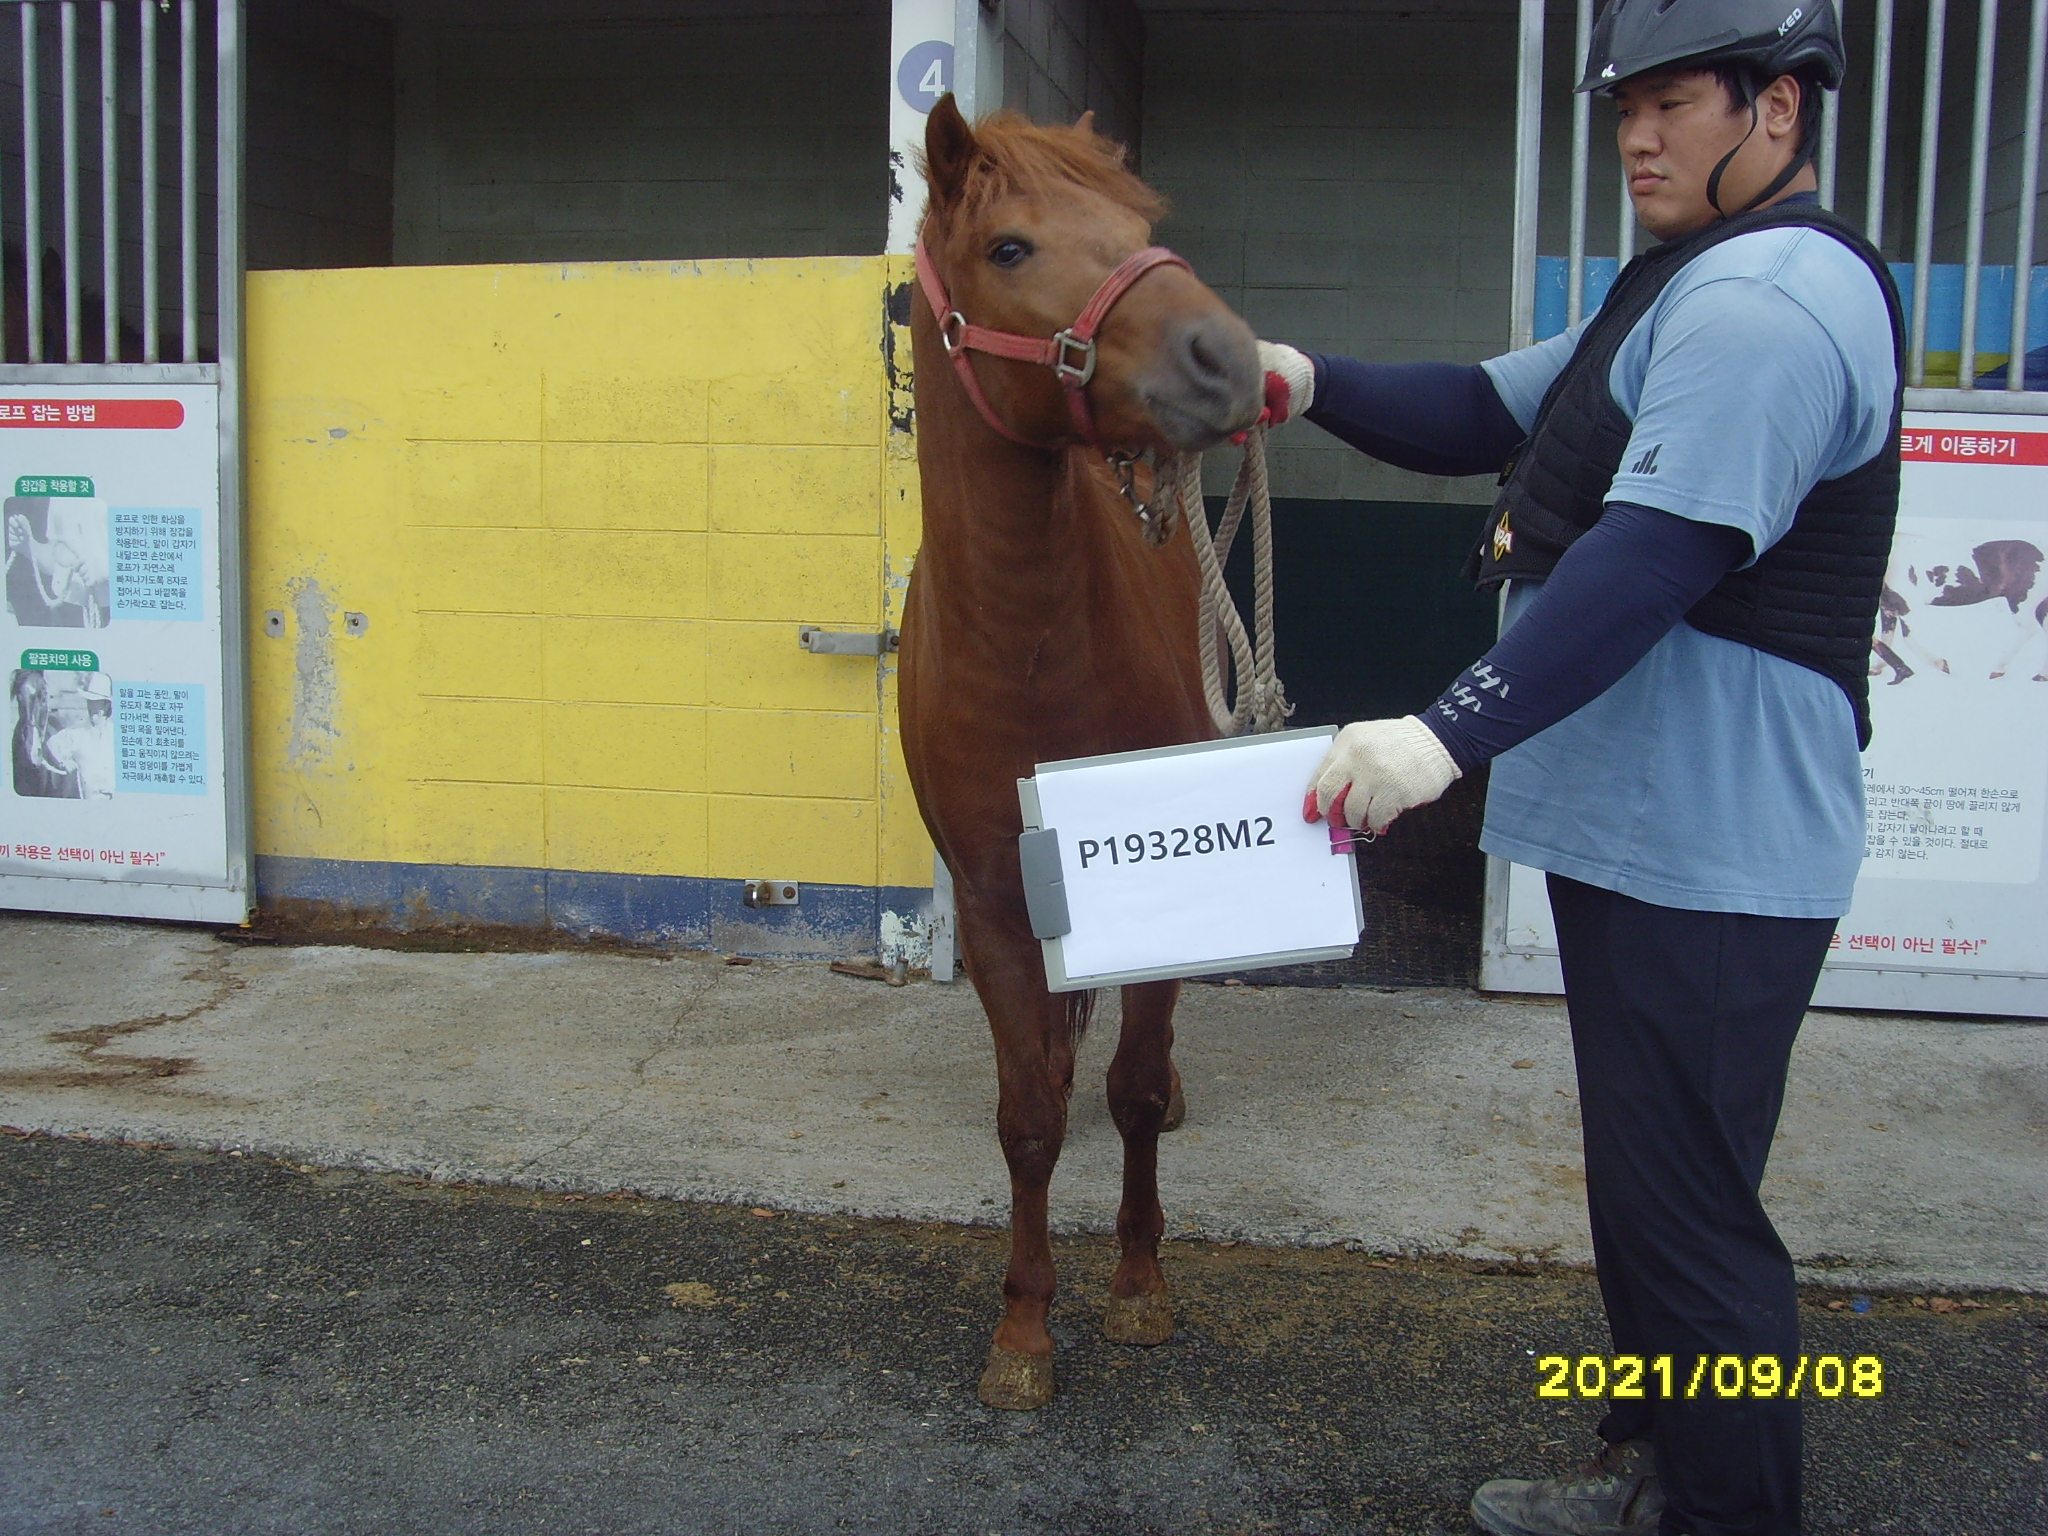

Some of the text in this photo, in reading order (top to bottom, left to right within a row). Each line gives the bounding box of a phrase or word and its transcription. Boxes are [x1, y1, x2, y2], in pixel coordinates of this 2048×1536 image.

[1777, 7, 1802, 37] KED
[918, 58, 946, 98] 4
[0, 405, 95, 421] 로프 잡는 방법
[1941, 436, 2016, 457] 이동하기
[21, 480, 88, 492] 장갑을 착용할 것
[115, 515, 185, 524] 로프로 인한 화상을
[115, 526, 193, 537] 방지하기 위해 장갑을
[116, 539, 196, 549] 착용한다. 말이 갑자기
[151, 552, 183, 561] 손안에서
[116, 563, 175, 573] 로프가 자연스레
[167, 576, 188, 585] 8자로
[117, 587, 141, 596] 접어서
[117, 600, 186, 610] 손가락으로 잡는다.
[29, 653, 92, 667] 팔꿈치의 사용
[137, 690, 151, 698] 끄는
[174, 690, 188, 700] 말이
[120, 701, 142, 710] 유도자
[120, 713, 184, 723] 다가서면 팔꿈치로
[120, 725, 135, 734] 말의
[138, 725, 152, 734] 목을
[121, 736, 184, 748] 왼손에 긴 회초리를
[139, 749, 167, 759] 움직이지
[170, 750, 199, 760] 않으려는
[122, 760, 193, 772] 말의 엉덩이를 가볍게
[123, 772, 205, 784] 자극해서 재촉할 수 있다.
[1862, 768, 1874, 779] 기
[1864, 784, 1895, 794] 레에서
[1948, 787, 1977, 798] 떨어져
[1981, 788, 2019, 799] 한손으로
[1891, 798, 1919, 808] 반대쪽
[1923, 799, 1942, 809] 끝이
[1946, 800, 1965, 810] 땅에
[1969, 801, 1997, 812] 끌리지
[2002, 802, 2020, 813] 않게
[1878, 810, 1908, 820] 잡는다.
[1877, 823, 1905, 833] 갑자기
[1910, 824, 1957, 835] 달아나려고
[1961, 826, 1970, 836] 할
[1974, 827, 1983, 836] 때
[1078, 817, 1276, 869] P19328M2
[1889, 836, 1898, 846] 수
[1903, 836, 1921, 847] 있을
[1925, 838, 1955, 848] 것이다.
[1960, 839, 1989, 849] 절대로
[15, 845, 51, 860] 착용은
[57, 847, 95, 862] 선택이
[100, 849, 125, 864] 아닌
[1876, 849, 1894, 858] 감지
[1898, 849, 1928, 860] 않는다.
[1848, 934, 1895, 951] 선택이
[1902, 937, 1934, 953] 아닌
